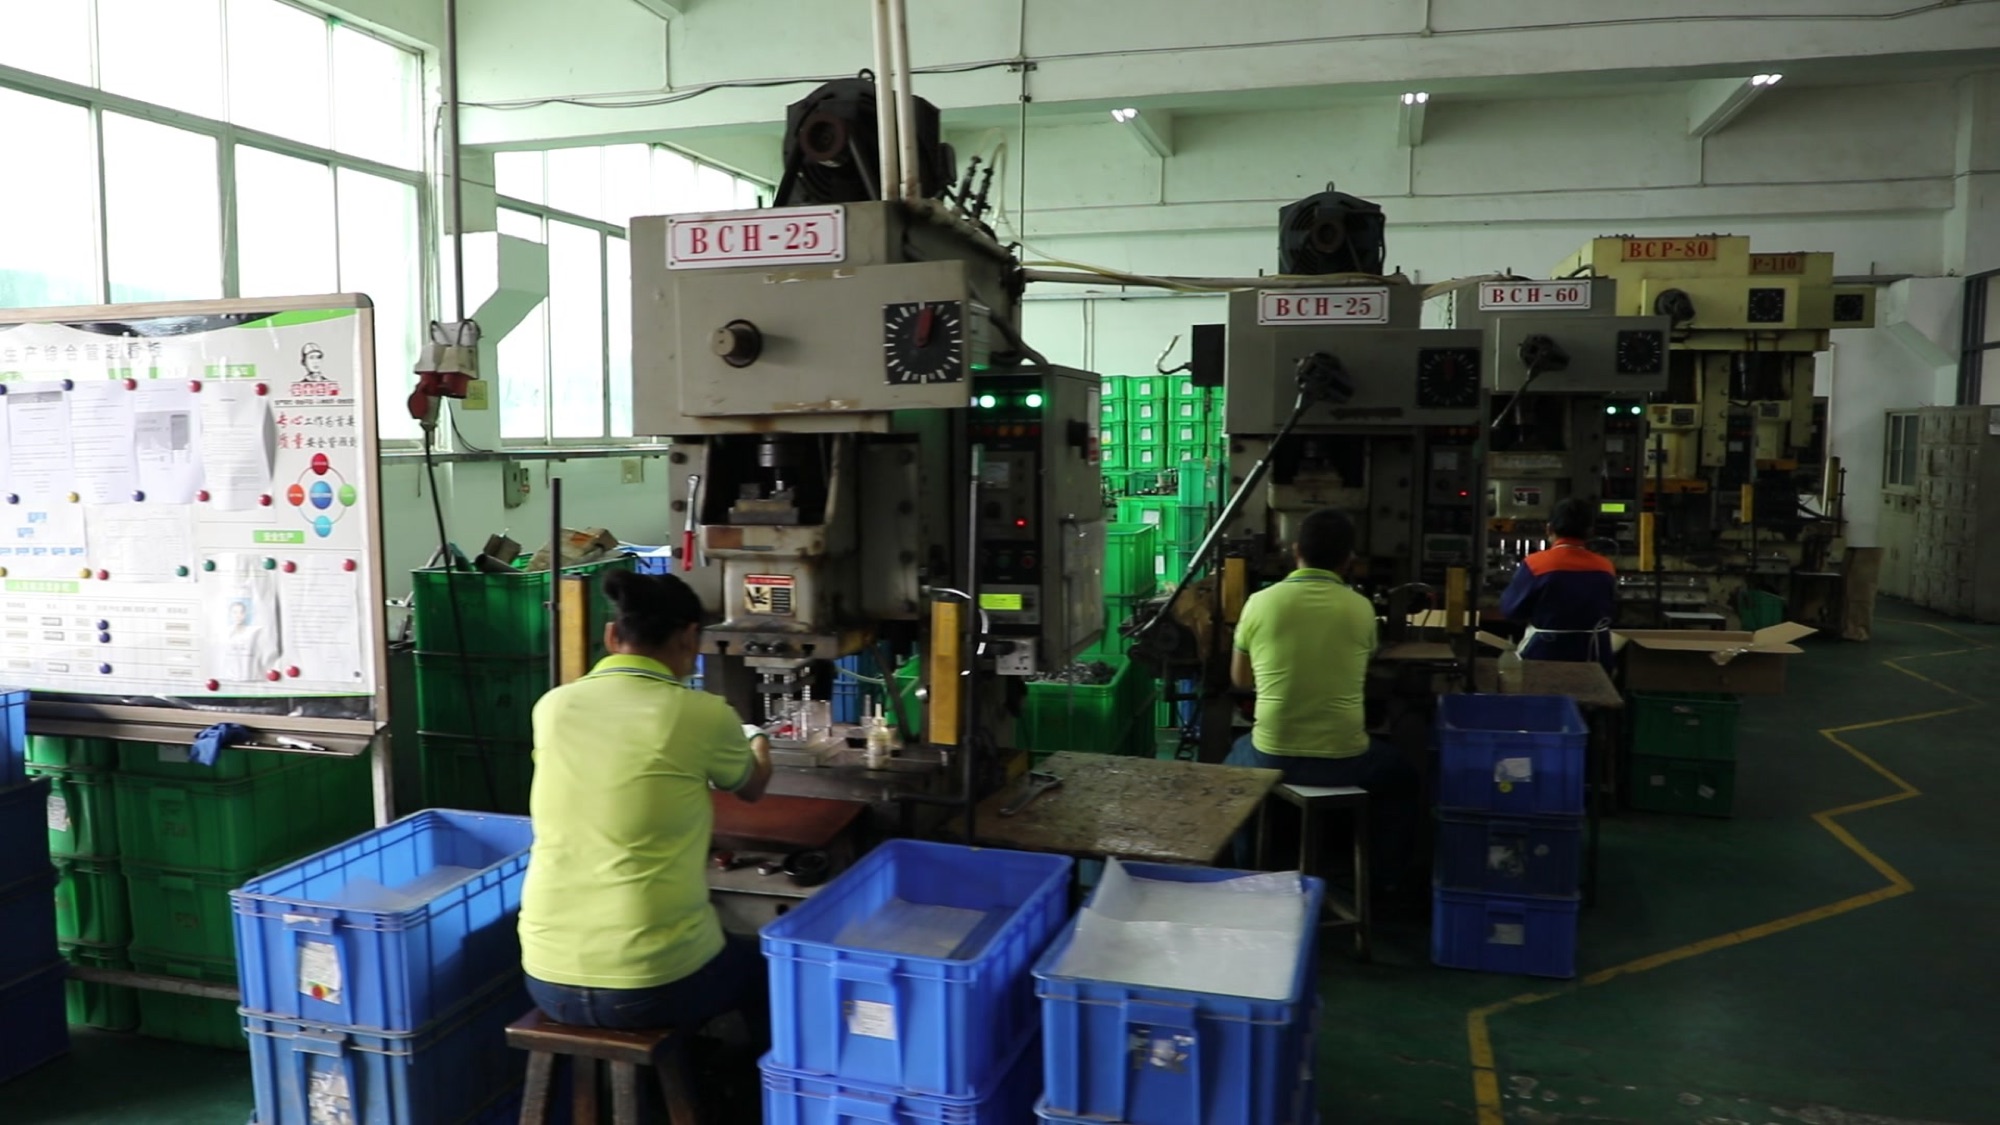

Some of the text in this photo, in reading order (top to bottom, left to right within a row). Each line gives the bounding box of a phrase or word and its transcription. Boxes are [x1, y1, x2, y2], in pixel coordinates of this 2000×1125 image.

[689, 222, 820, 254] BCH-25
[1629, 241, 1709, 258] BCP-80
[1492, 287, 1579, 303] BCH-60
[1276, 297, 1372, 317] BCH-25
